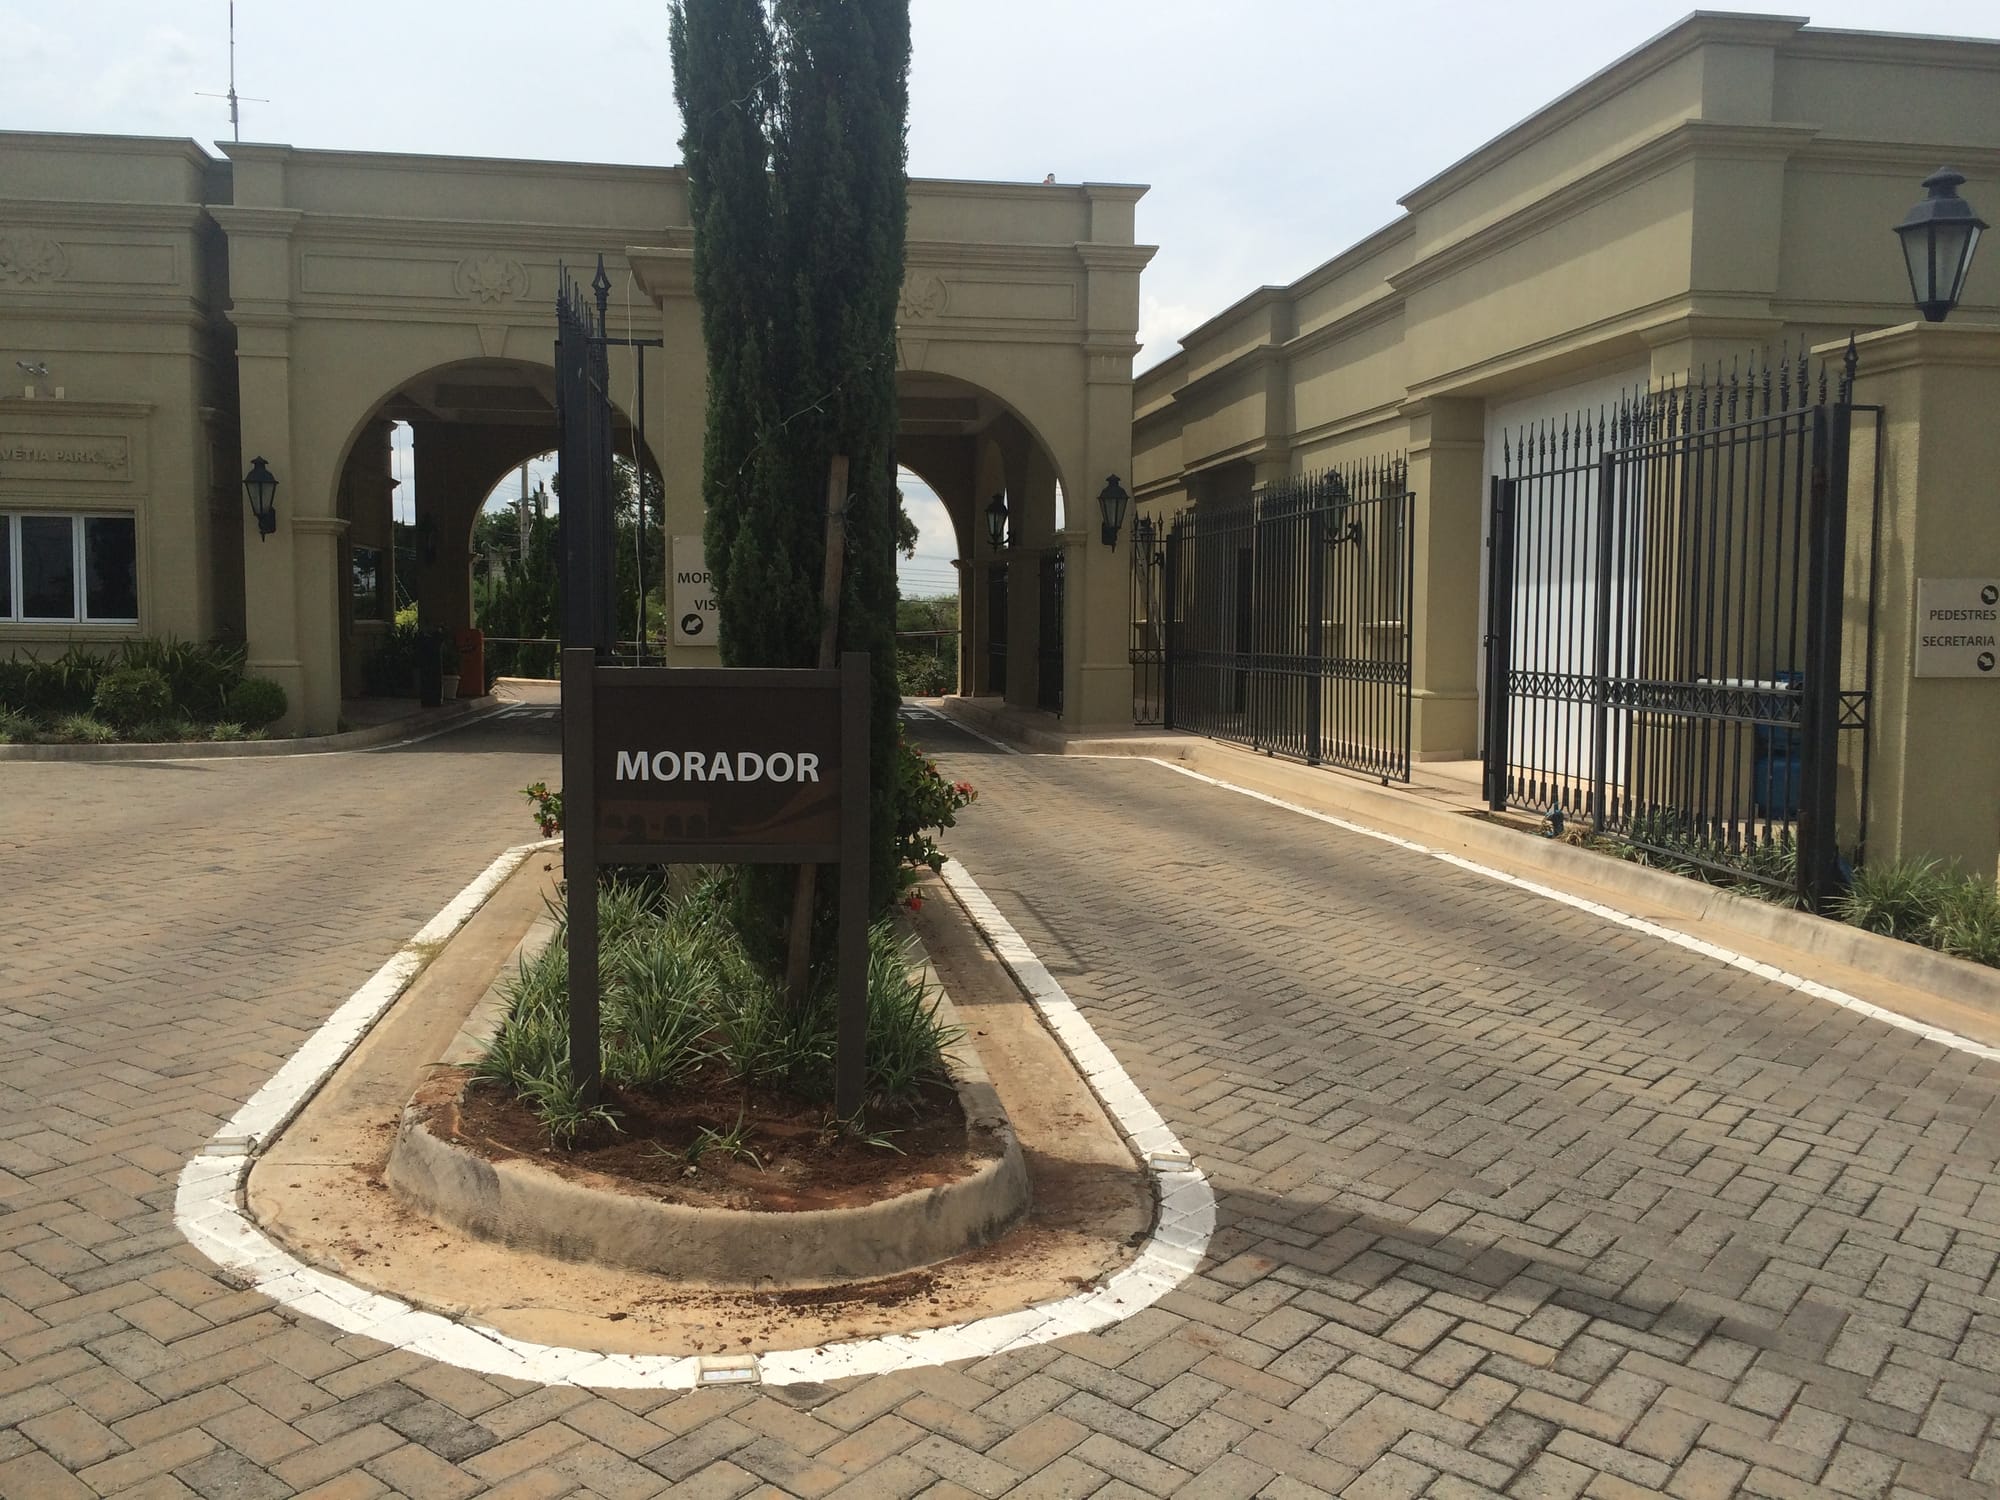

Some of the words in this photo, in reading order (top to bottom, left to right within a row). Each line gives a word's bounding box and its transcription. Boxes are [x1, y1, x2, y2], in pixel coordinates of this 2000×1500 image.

[56, 449, 98, 463] PARK
[677, 572, 712, 584] MOR
[694, 599, 719, 611] VIS
[1929, 609, 1997, 621] PEDESTRES
[1922, 636, 1996, 647] SECRETARIA
[615, 750, 820, 783] MORADOR
